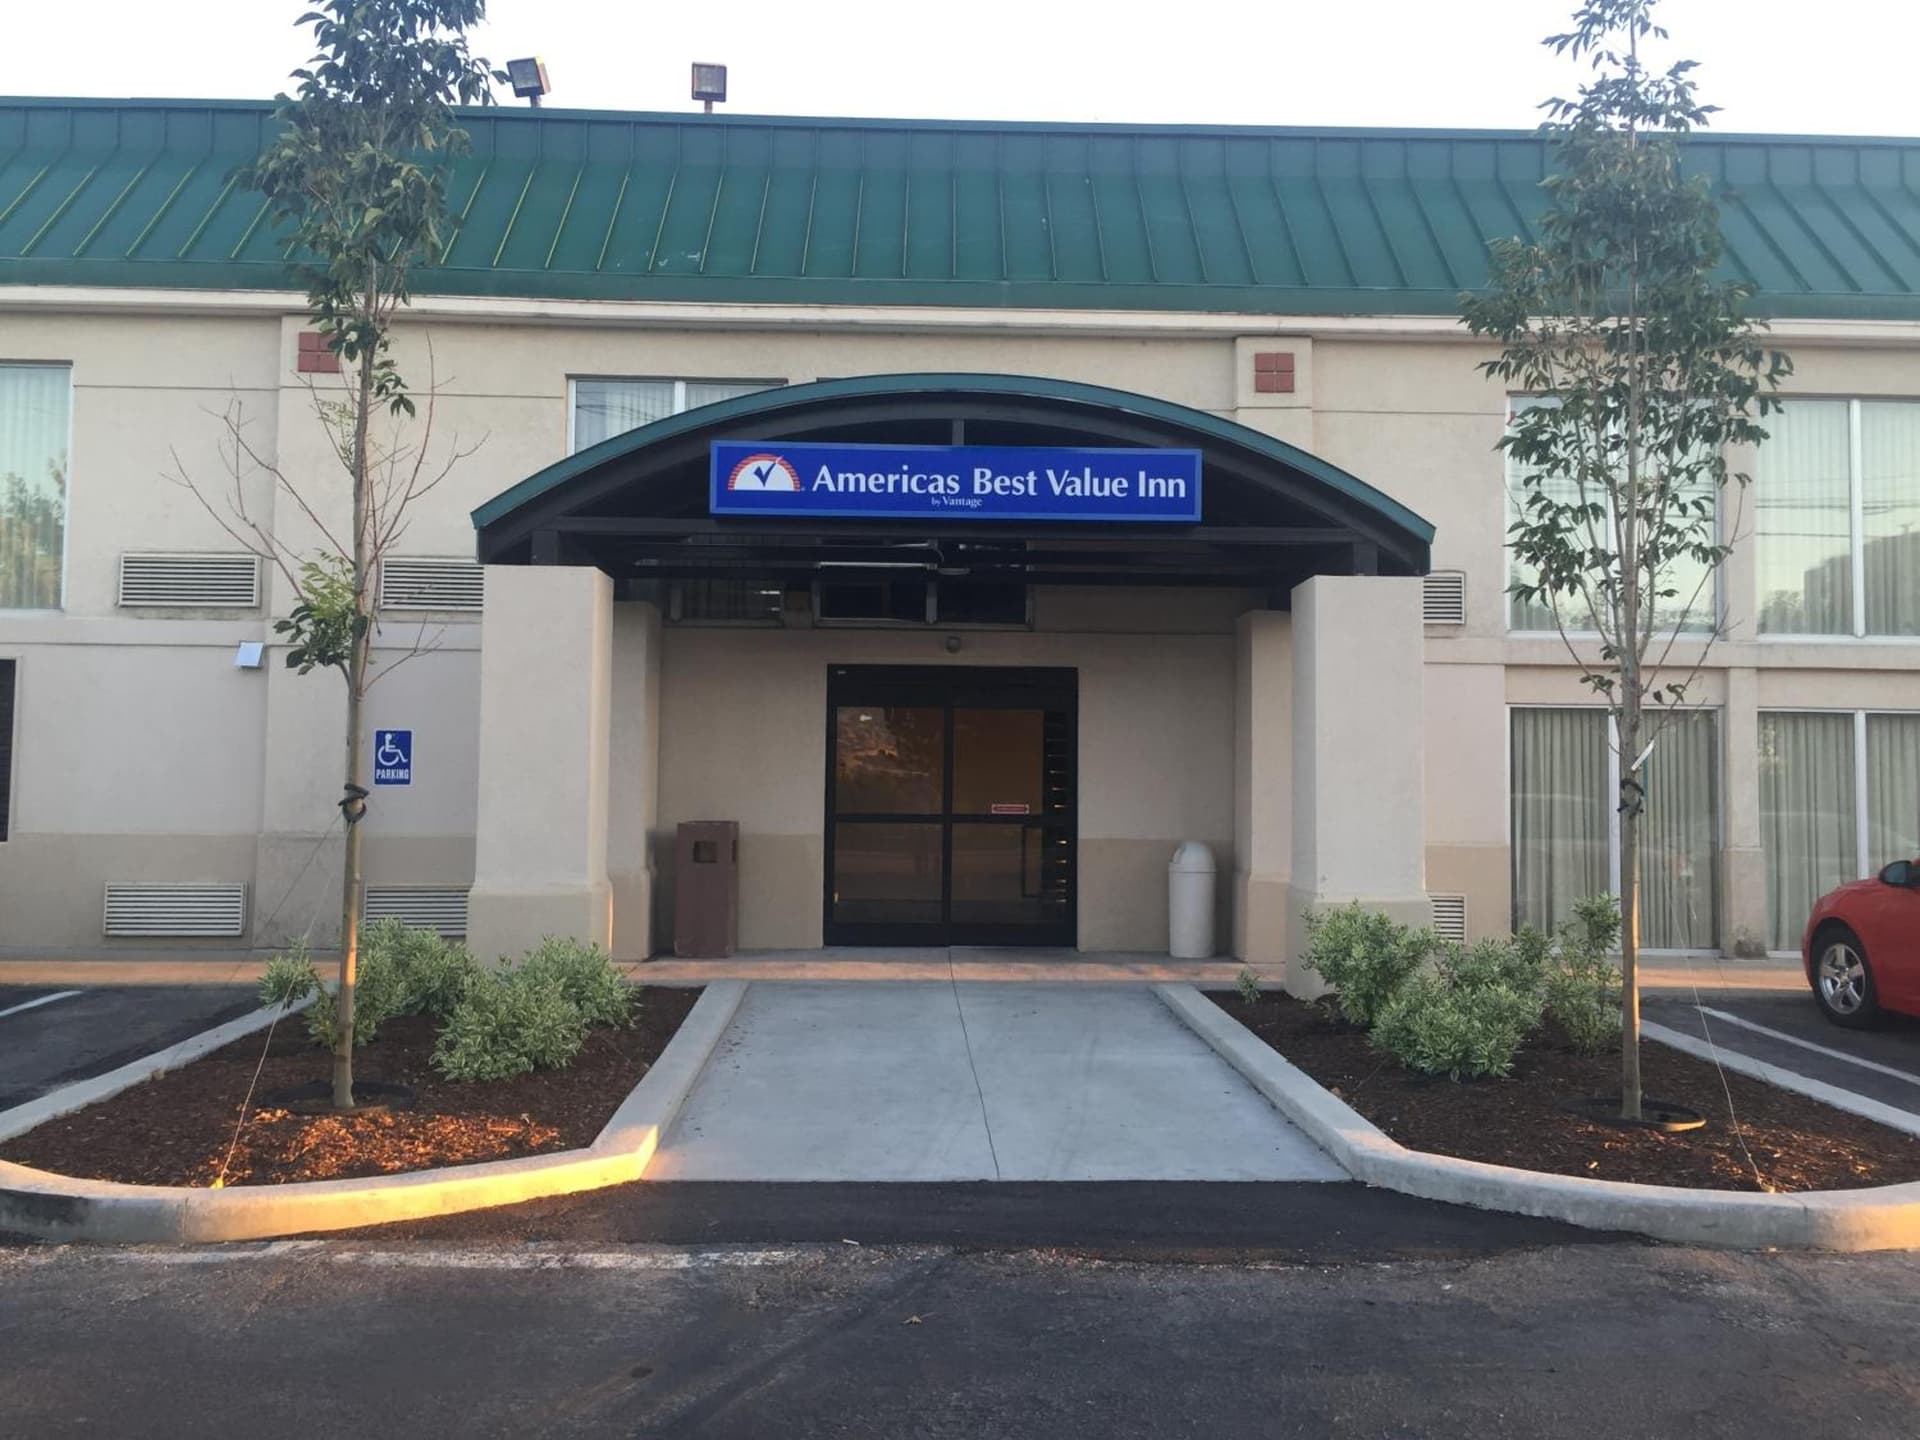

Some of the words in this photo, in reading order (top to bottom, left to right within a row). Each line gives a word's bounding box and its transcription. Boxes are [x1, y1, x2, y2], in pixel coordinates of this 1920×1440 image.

[811, 464, 960, 494] Americas
[973, 467, 1038, 496] Best
[1045, 467, 1129, 497] Value
[1138, 470, 1187, 498] Inn
[931, 496, 941, 507] by
[942, 496, 983, 508] Vantage
[376, 769, 409, 779] PARKING
